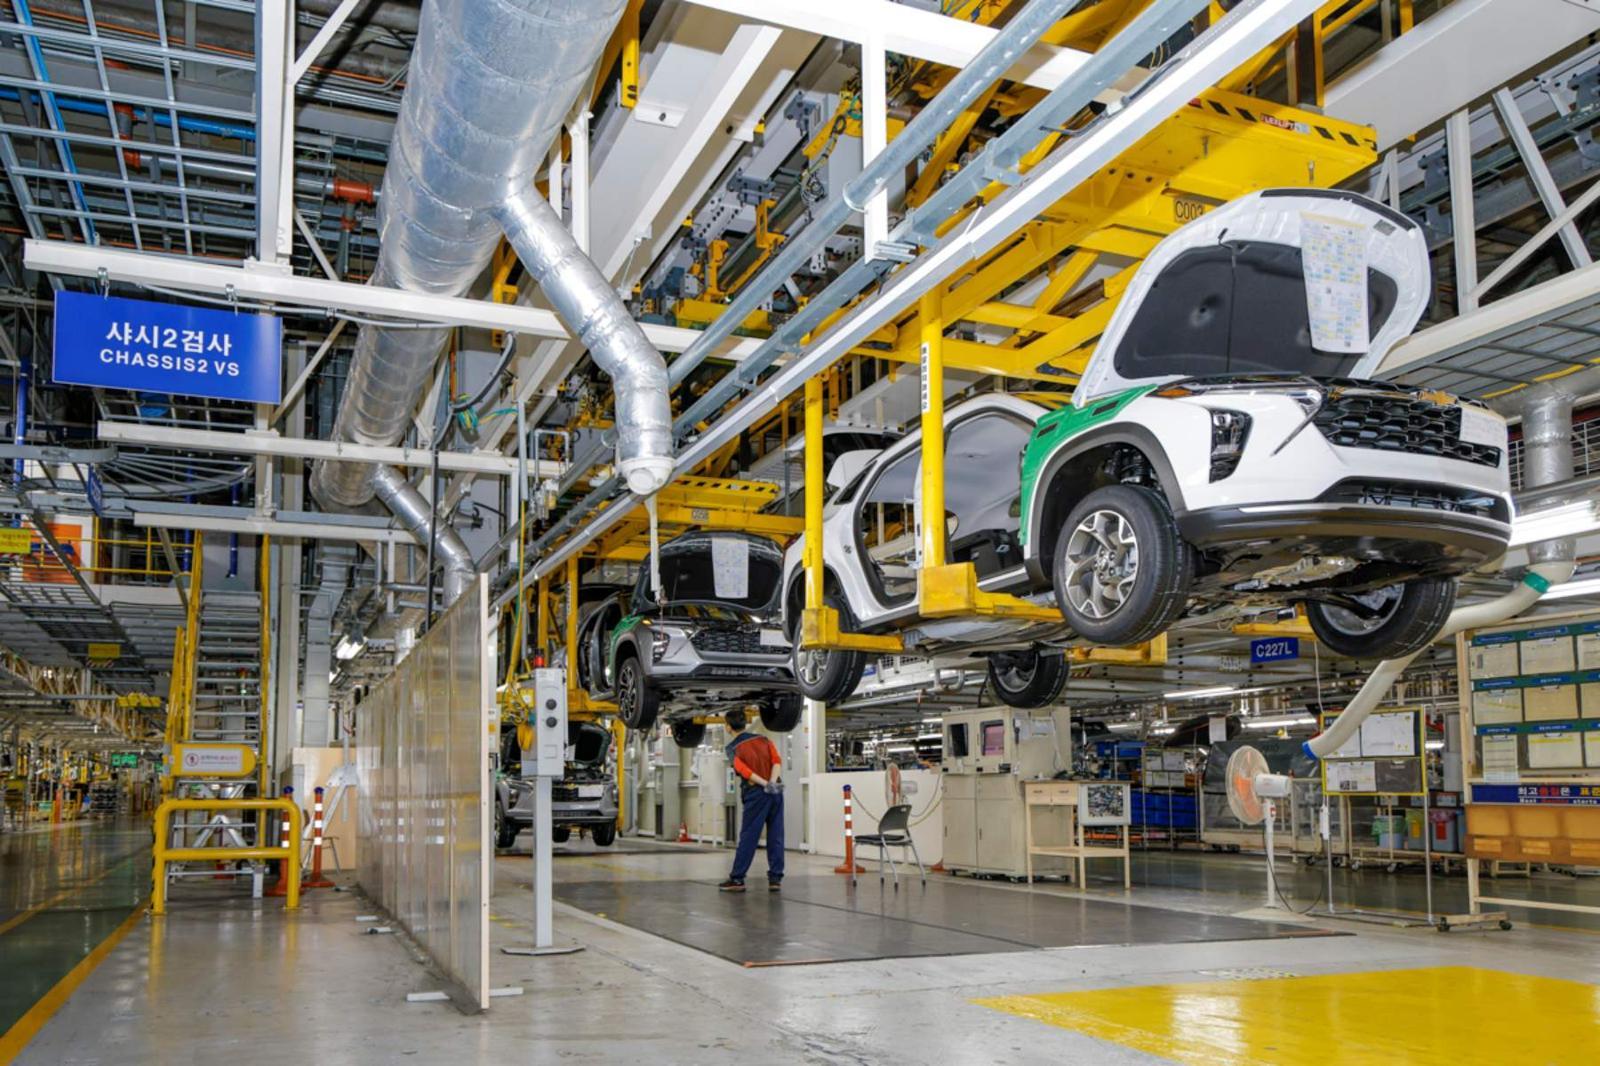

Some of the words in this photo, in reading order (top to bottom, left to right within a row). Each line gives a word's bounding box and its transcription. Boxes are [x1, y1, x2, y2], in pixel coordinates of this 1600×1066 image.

[105, 321, 233, 357] 샤시2검사
[100, 348, 209, 374] CHASSIS2
[214, 360, 240, 377] VS
[1255, 641, 1293, 658] C227L
